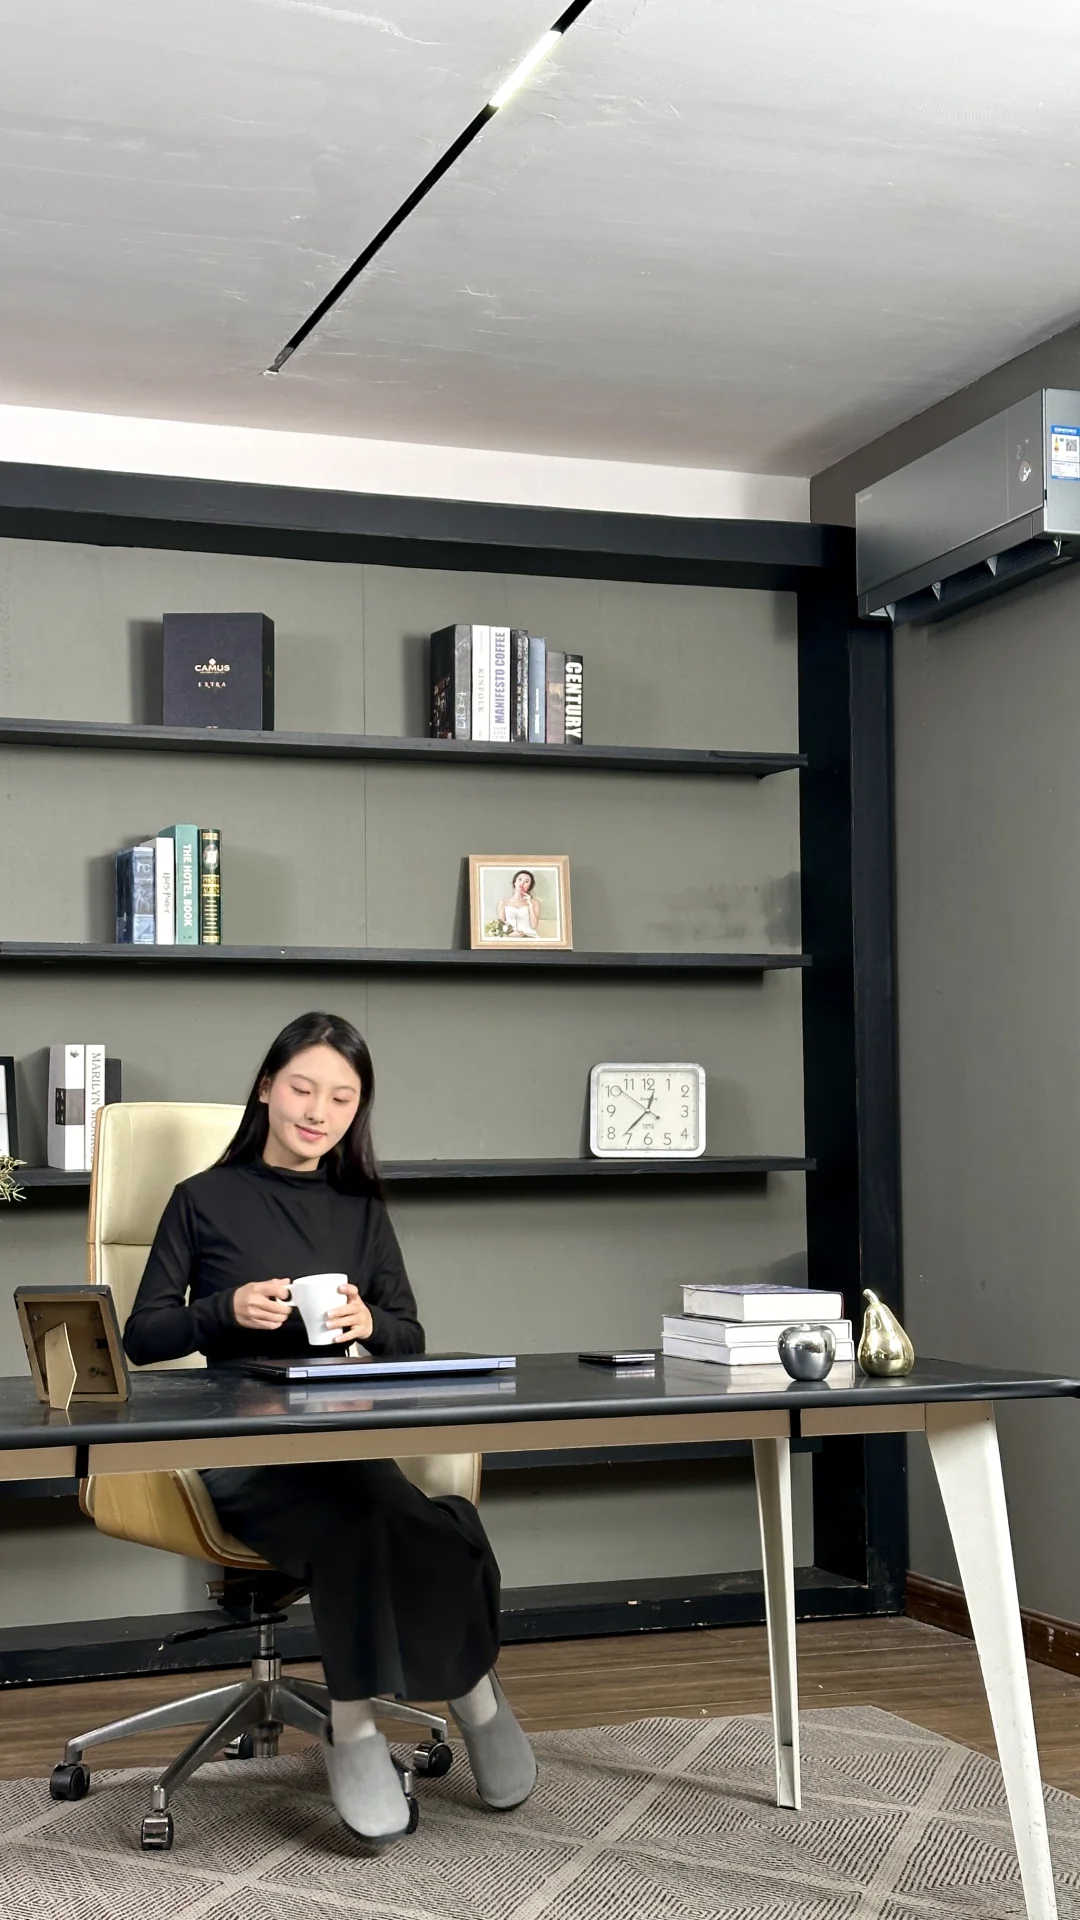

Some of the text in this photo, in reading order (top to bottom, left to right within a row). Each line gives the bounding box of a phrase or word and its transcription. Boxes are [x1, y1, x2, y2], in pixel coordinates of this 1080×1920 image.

[494, 631, 506, 667] COFFEE
[194, 664, 231, 672] CAMUS
[494, 669, 506, 725] MANIFESTO
[565, 661, 583, 739] CENTURY
[182, 843, 192, 864] THE
[183, 865, 192, 897] HOTEL
[183, 899, 193, 927] BOOK
[91, 1052, 101, 1106] MARILYN
[623, 1078, 635, 1091] 11
[641, 1077, 656, 1091] 12
[665, 1078, 671, 1091] 1
[605, 1085, 622, 1098] 10
[680, 1084, 690, 1098] 2
[606, 1104, 616, 1118] 9
[680, 1104, 690, 1118] 3
[607, 1126, 616, 1140] 8
[625, 1132, 633, 1146] 7
[643, 1132, 653, 1146] 6
[662, 1132, 672, 1146] 5
[680, 1127, 690, 1140] 4
